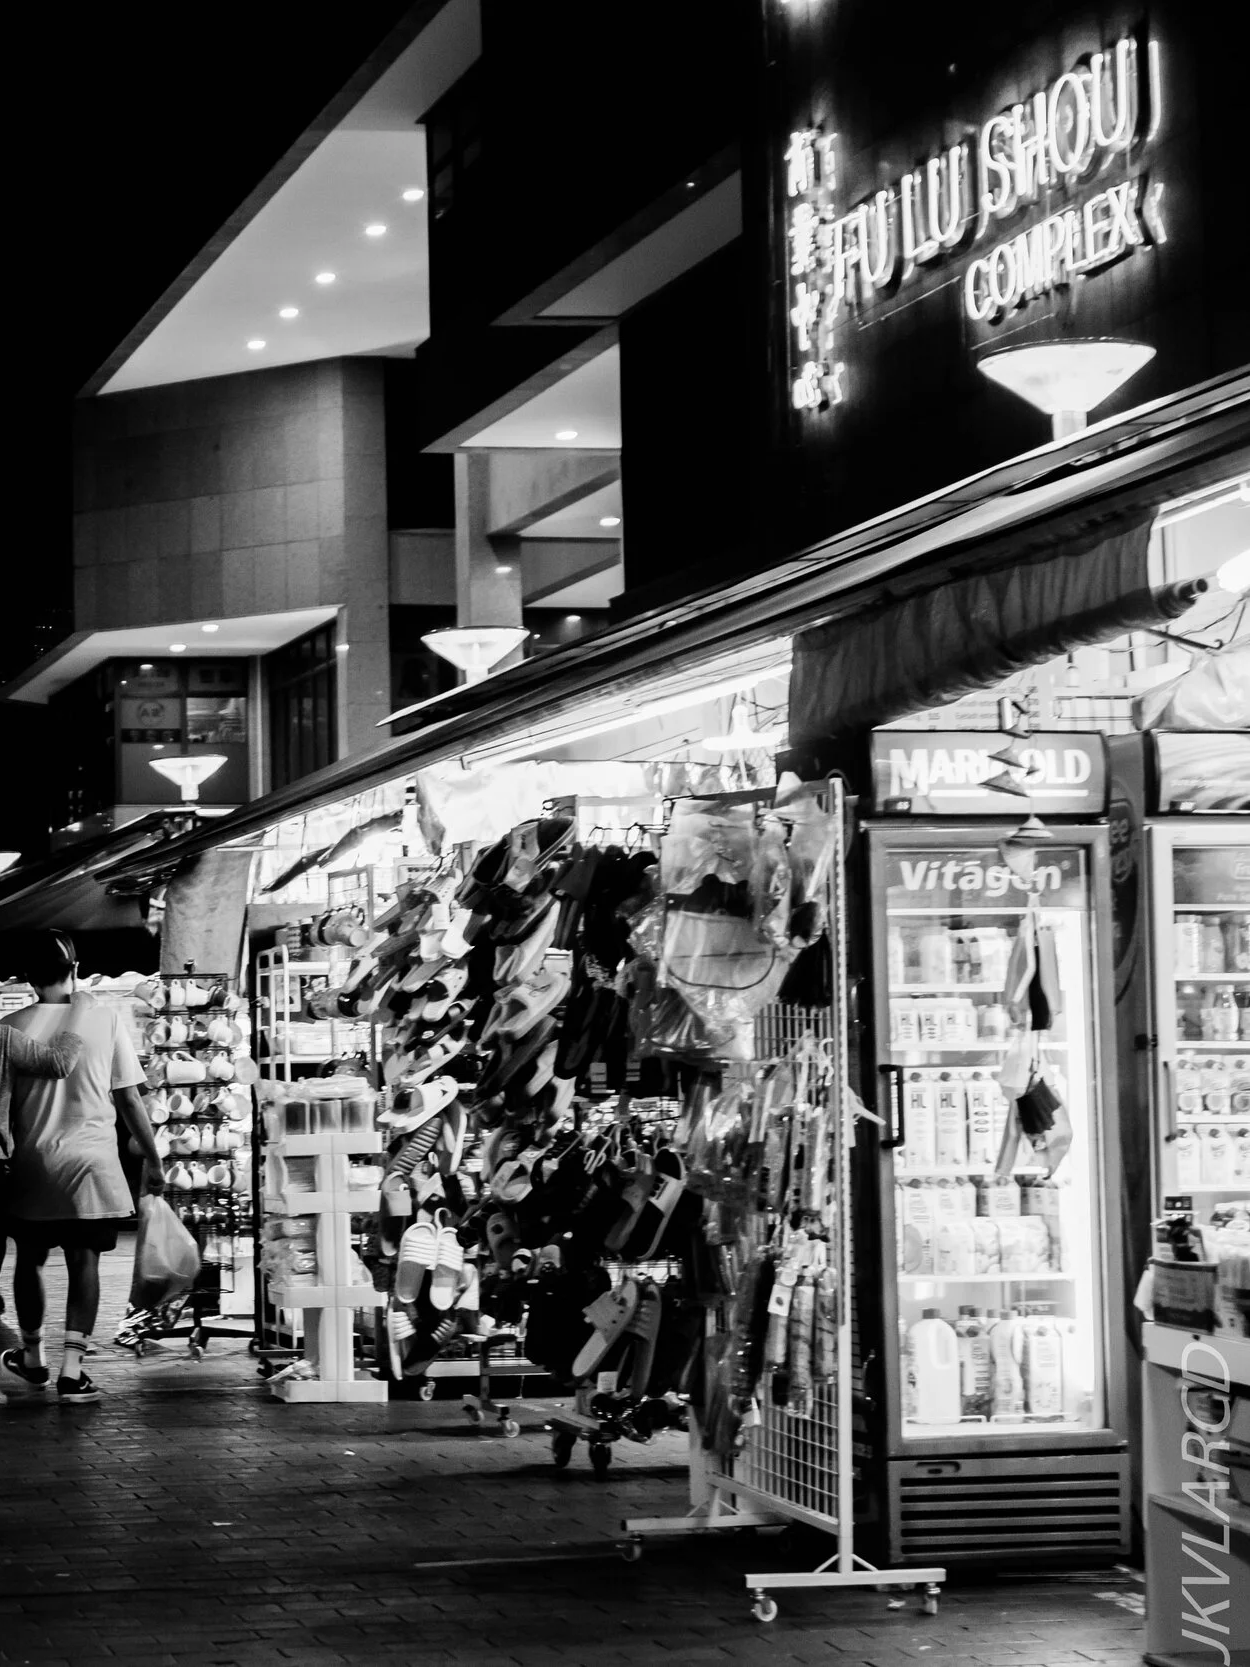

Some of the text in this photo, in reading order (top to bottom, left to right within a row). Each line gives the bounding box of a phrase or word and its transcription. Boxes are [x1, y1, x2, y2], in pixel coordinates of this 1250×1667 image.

[827, 38, 1128, 303] FU LU SHOU
[964, 182, 1138, 320] COMPLEX
